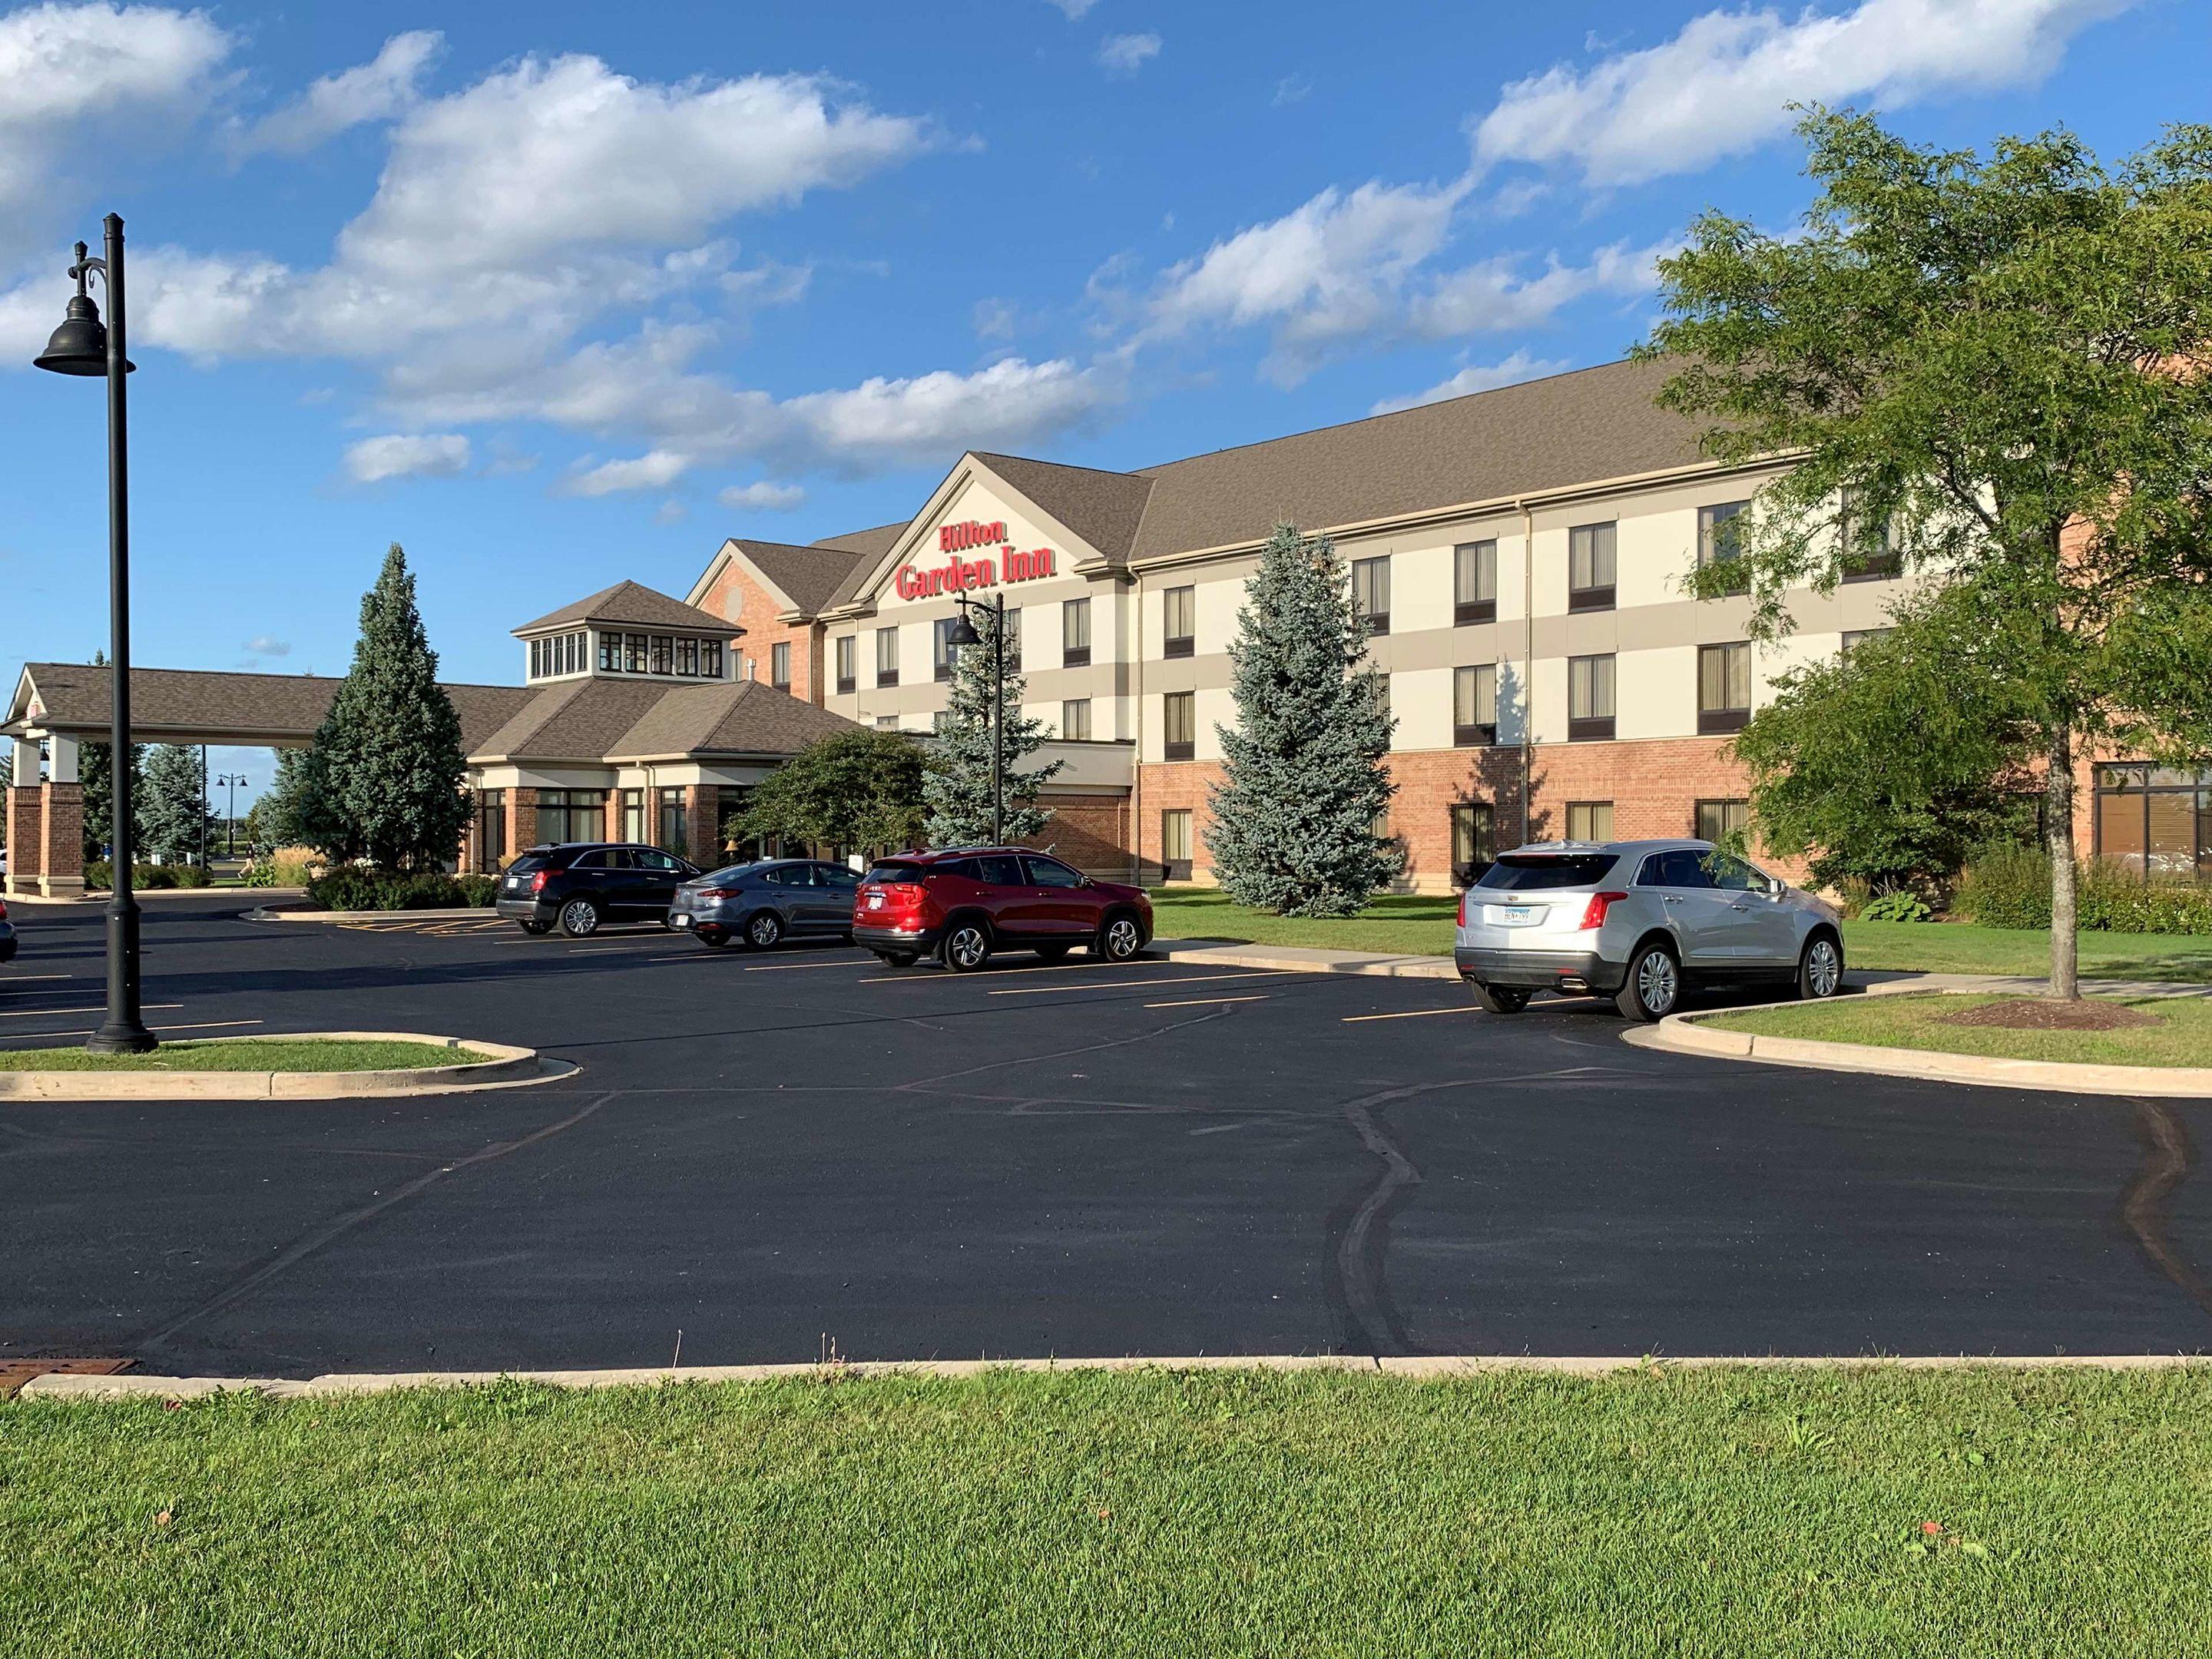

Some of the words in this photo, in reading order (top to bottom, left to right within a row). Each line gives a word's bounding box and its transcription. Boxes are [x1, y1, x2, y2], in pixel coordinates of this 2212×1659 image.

[939, 520, 1005, 551] Hilton
[896, 555, 994, 600] Garden
[1001, 545, 1056, 581] Inn
